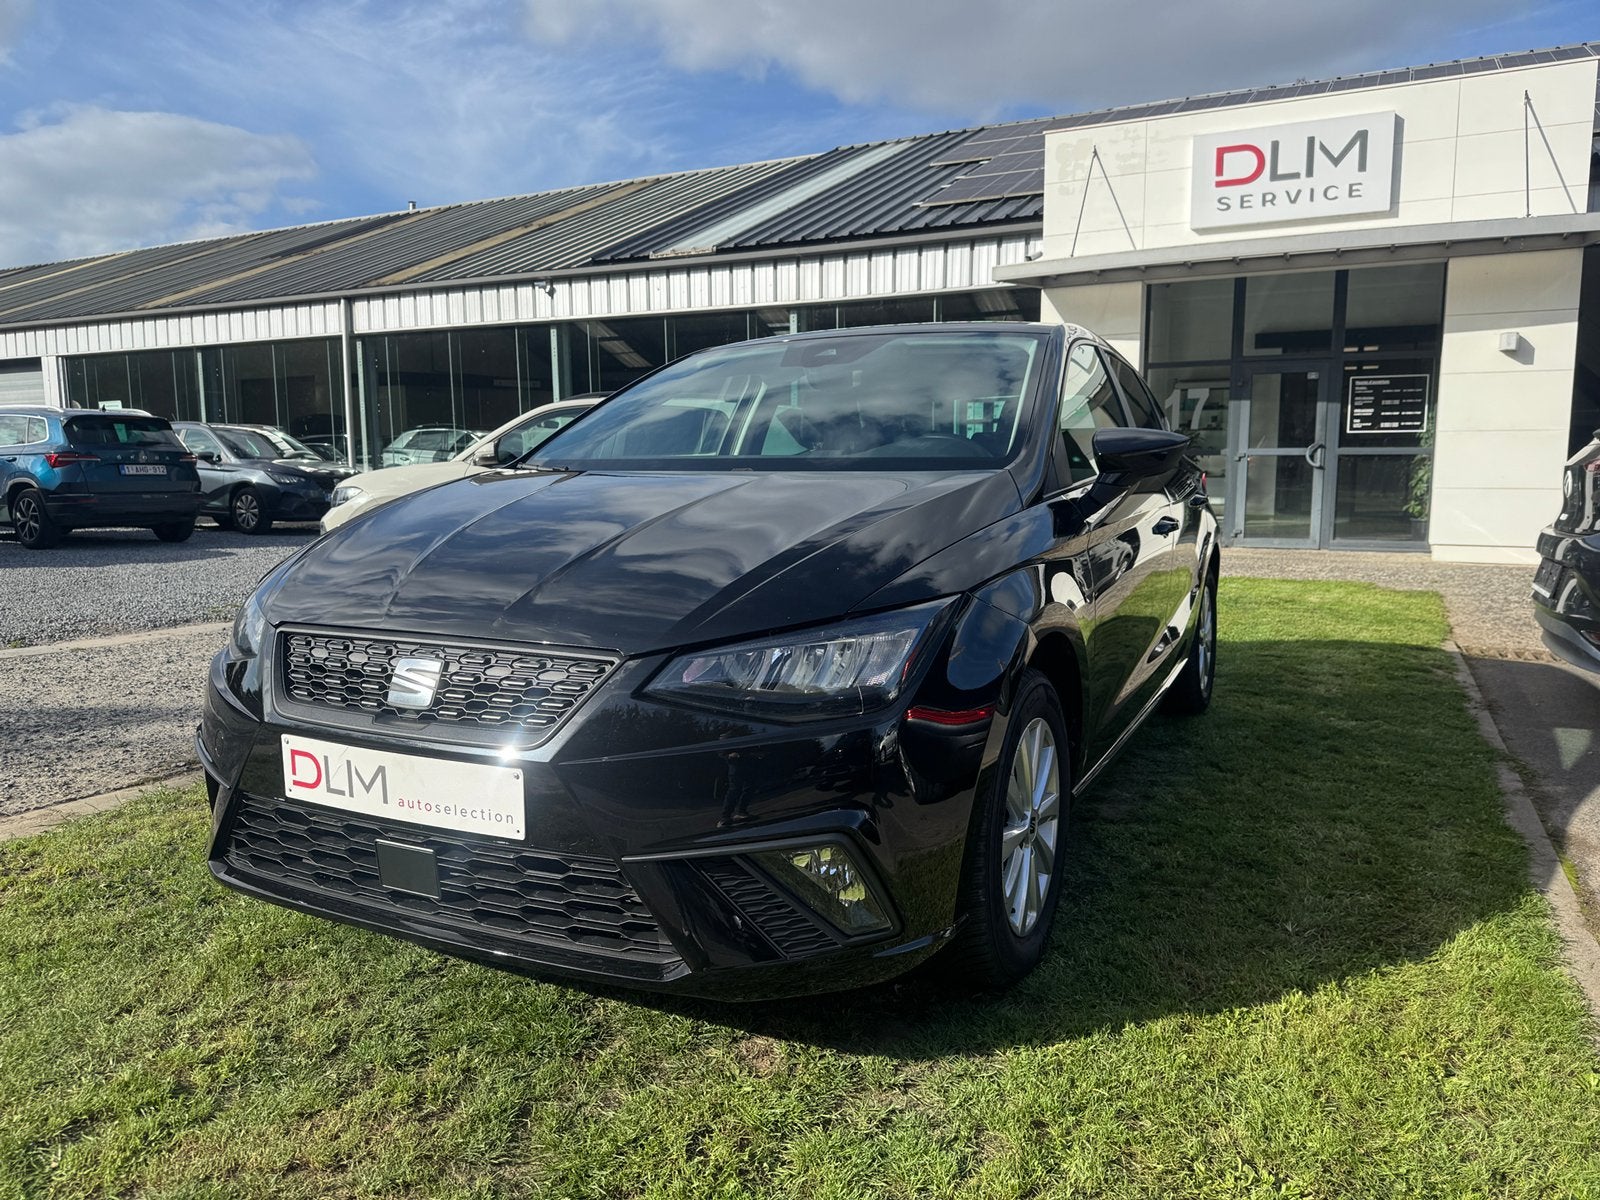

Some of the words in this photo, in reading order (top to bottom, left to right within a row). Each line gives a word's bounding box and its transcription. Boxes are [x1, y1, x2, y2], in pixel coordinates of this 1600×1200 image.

[1215, 129, 1369, 188] DLM
[1216, 182, 1364, 212] SERVICE
[1164, 388, 1210, 431] 17
[290, 748, 389, 805] DLM
[398, 797, 515, 825] autoselection
